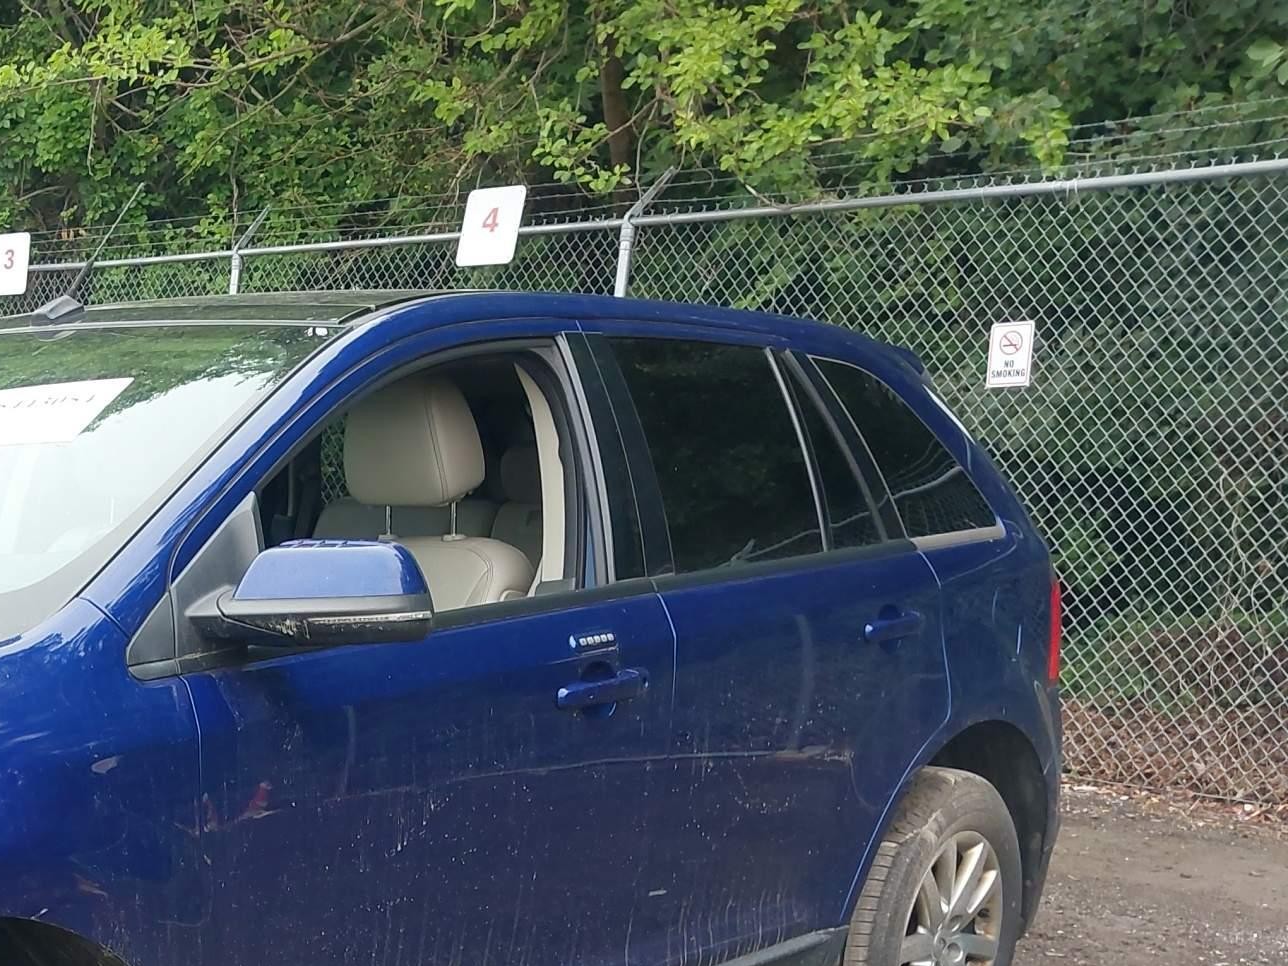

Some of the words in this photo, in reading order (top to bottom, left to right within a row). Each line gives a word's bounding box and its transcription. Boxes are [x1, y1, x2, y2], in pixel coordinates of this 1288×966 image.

[481, 207, 499, 233] 4
[3, 248, 15, 270] 3
[1003, 359, 1014, 368] NO
[991, 368, 1026, 379] SMOKING
